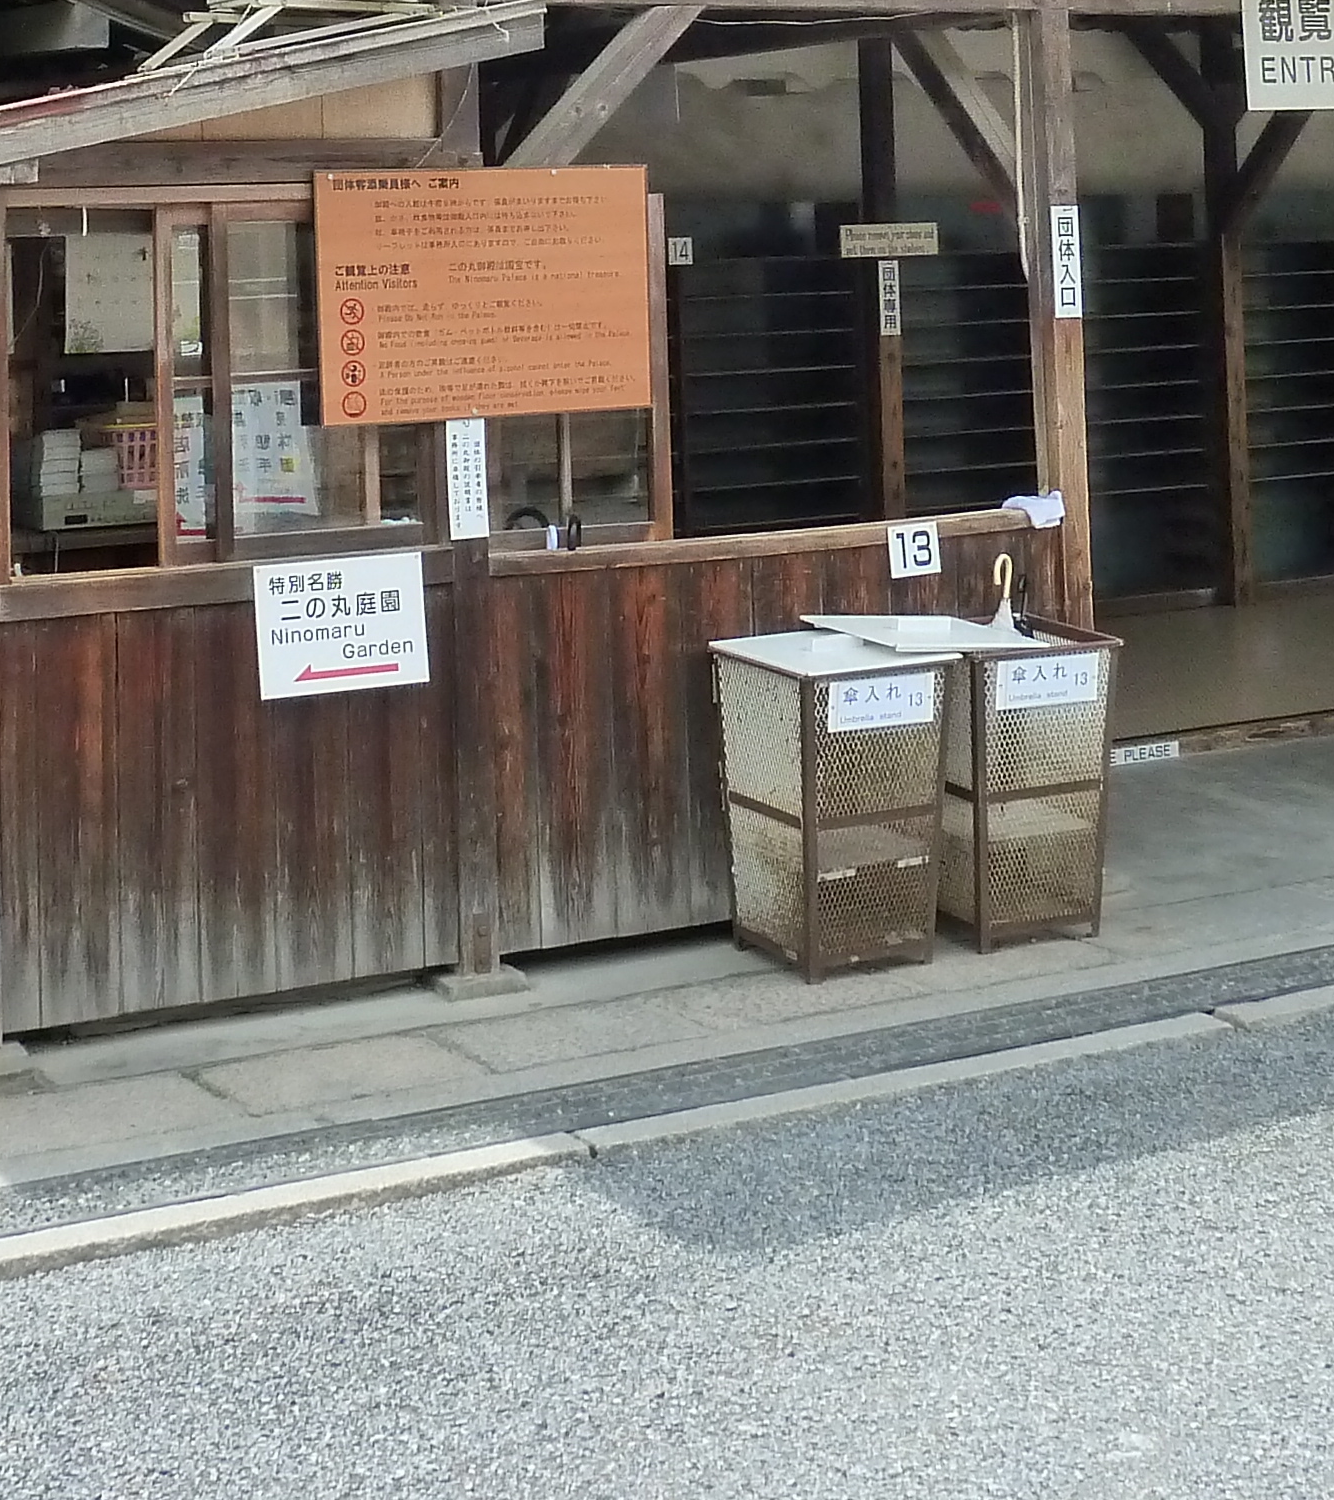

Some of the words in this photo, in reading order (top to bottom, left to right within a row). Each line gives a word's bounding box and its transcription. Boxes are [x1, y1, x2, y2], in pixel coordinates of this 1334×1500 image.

[671, 240, 689, 262] 14
[1057, 216, 1076, 307] 団体入口
[334, 263, 411, 277] ご観覧上の注意
[335, 278, 379, 292] Attention
[382, 277, 418, 290] Visitors
[895, 529, 932, 569] 13
[268, 570, 344, 596] 特別名勝
[280, 589, 401, 622] 二の丸庭園
[270, 622, 365, 646] Ninomaru
[342, 638, 414, 660] Garden
[1011, 661, 1068, 685] 傘入れ
[1073, 670, 1089, 687] 13
[842, 681, 902, 706] 傘入れ
[907, 691, 925, 708] 13
[1123, 743, 1172, 763] PLEASE
